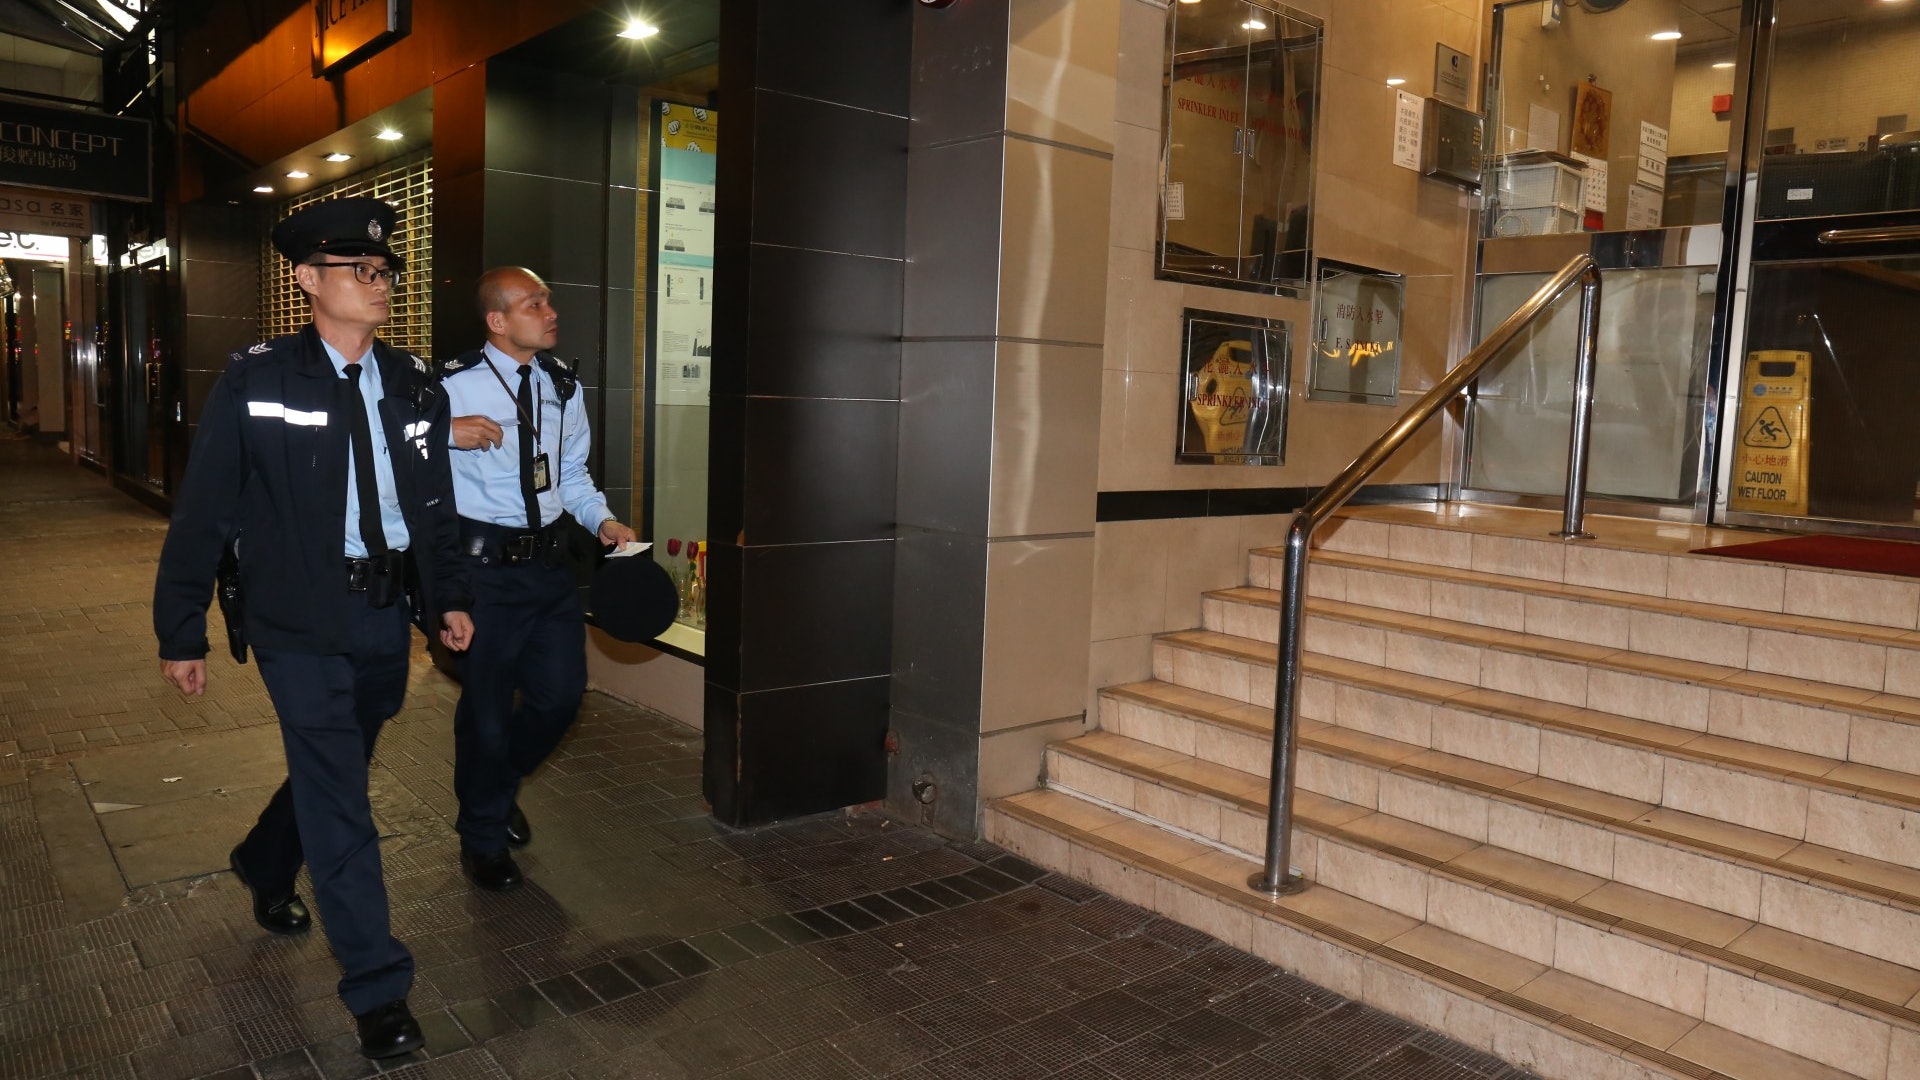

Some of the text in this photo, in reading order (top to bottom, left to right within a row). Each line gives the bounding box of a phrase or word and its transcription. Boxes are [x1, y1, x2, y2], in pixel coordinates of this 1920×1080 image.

[1178, 98, 1240, 123] SPRINKLER INLET
[0, 121, 124, 158] CONCEPT
[1197, 394, 1245, 409] SPRINKLER
[1742, 454, 1790, 467] 小心地滑
[1744, 470, 1782, 484] CAUTION
[1737, 486, 1787, 501] WET FLOOR
